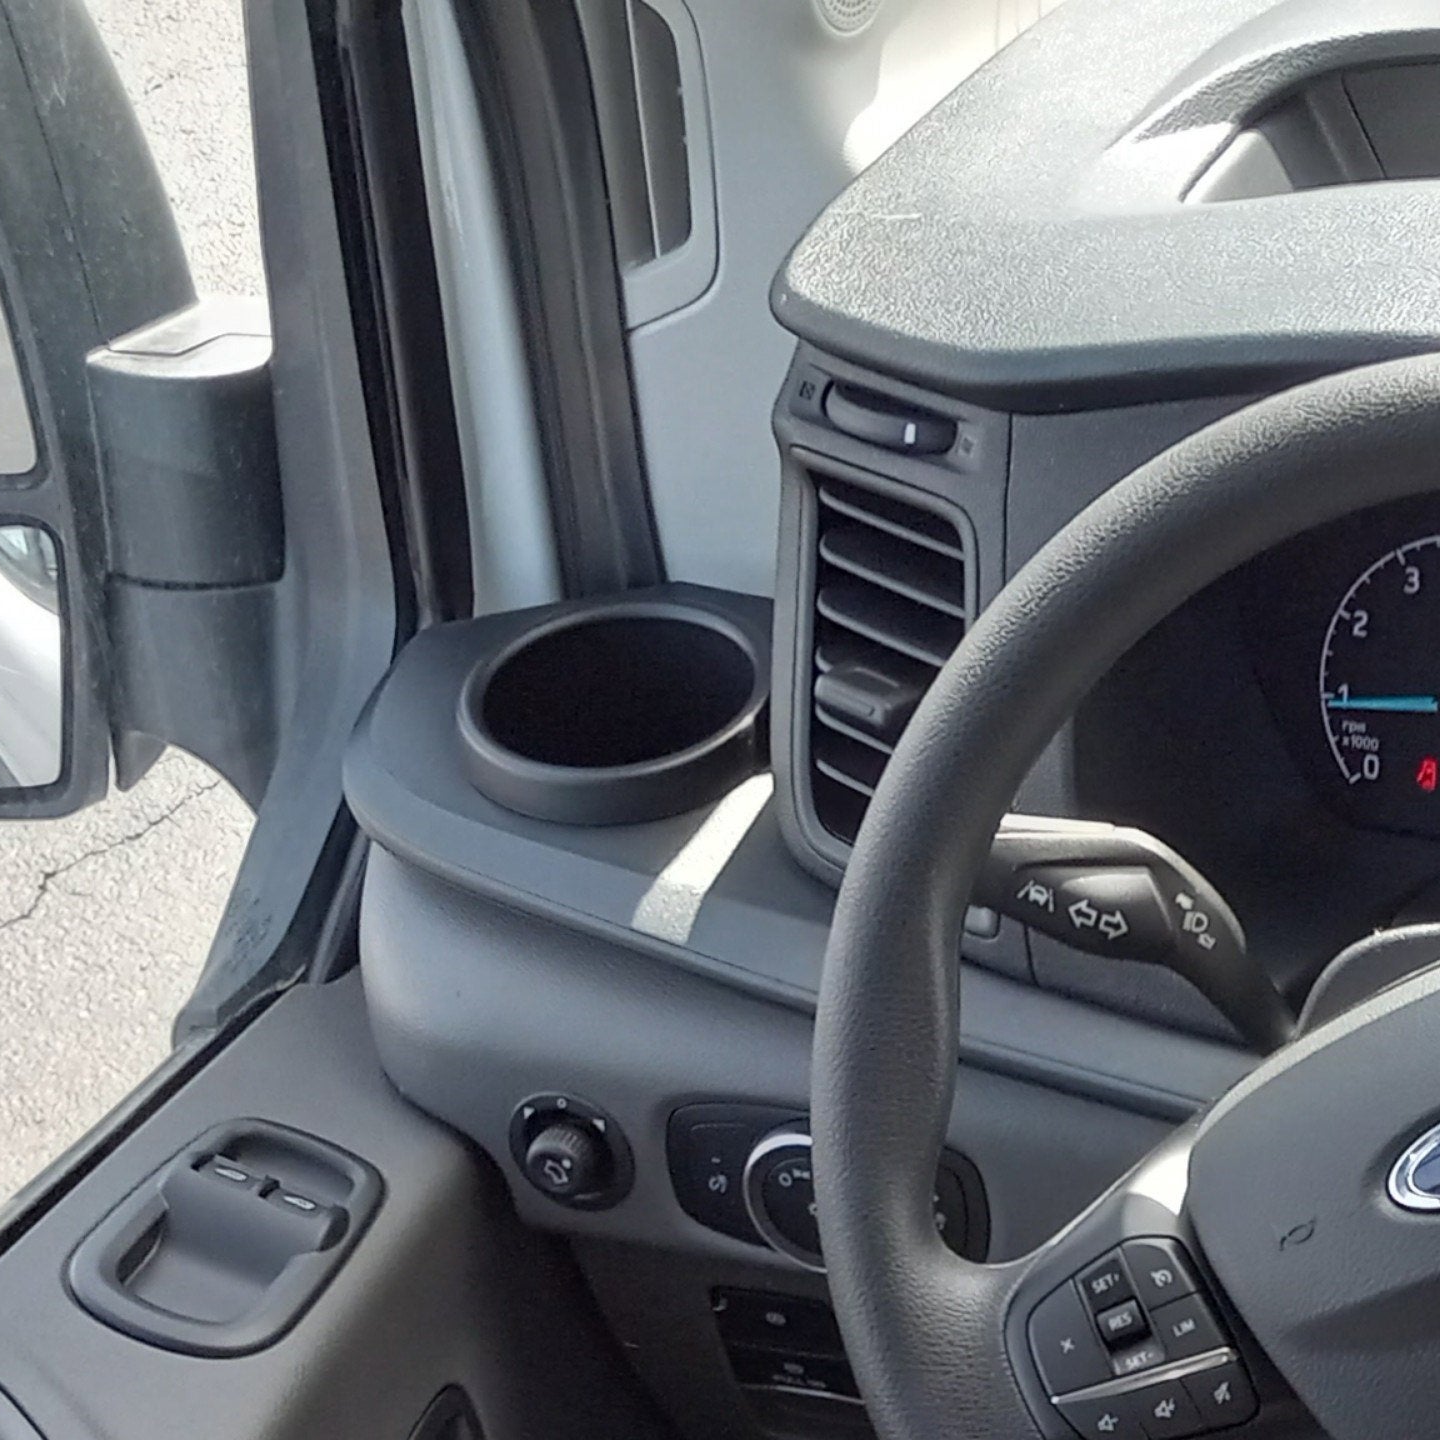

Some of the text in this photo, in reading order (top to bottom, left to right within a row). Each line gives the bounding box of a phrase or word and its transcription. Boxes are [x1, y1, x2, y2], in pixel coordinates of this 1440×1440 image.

[1403, 566, 1420, 594] 3
[1352, 610, 1369, 637] 2
[1363, 753, 1380, 780] 0
[1108, 1311, 1133, 1332] RES
[1172, 1317, 1197, 1337] LIM
